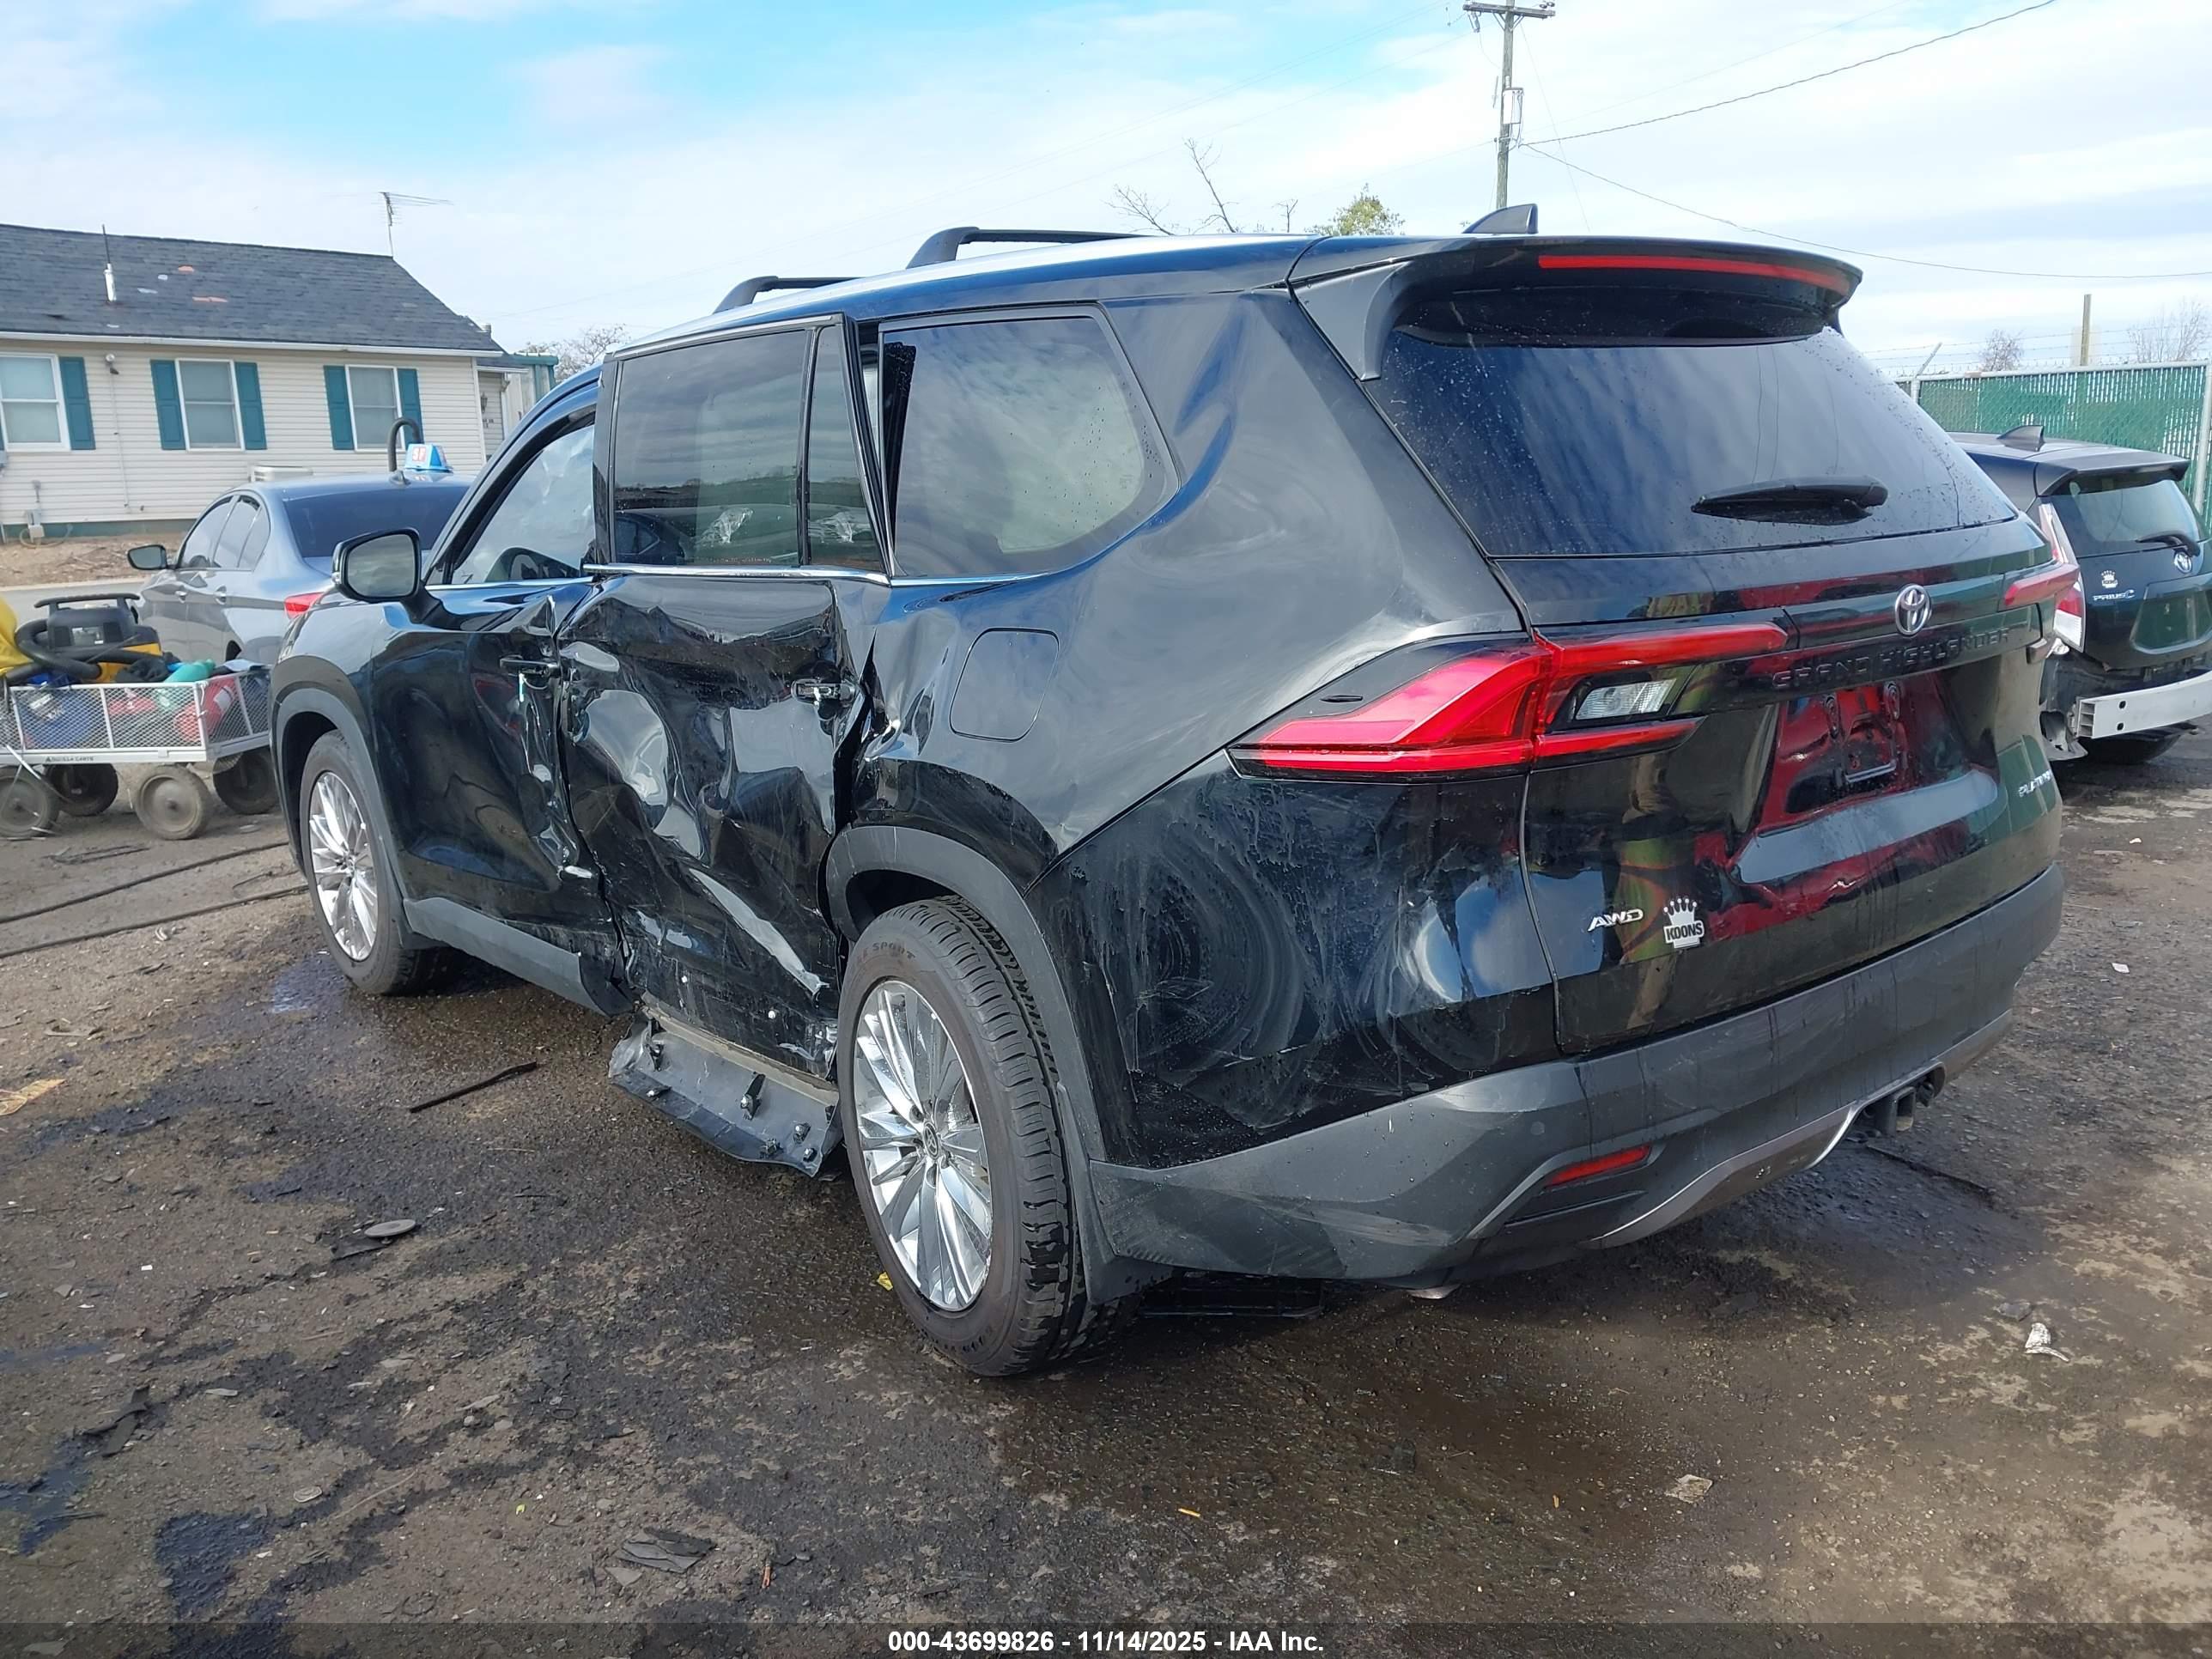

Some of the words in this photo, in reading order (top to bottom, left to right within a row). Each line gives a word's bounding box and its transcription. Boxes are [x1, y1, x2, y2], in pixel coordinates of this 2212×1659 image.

[2092, 592, 2125, 601] PRIUS
[1771, 655, 1869, 687] GRAND
[1879, 626, 2010, 666] HIGHLANDER
[2018, 769, 2052, 798] PLATIN
[1587, 908, 1644, 932] AWD
[1666, 923, 1703, 940] KOONS
